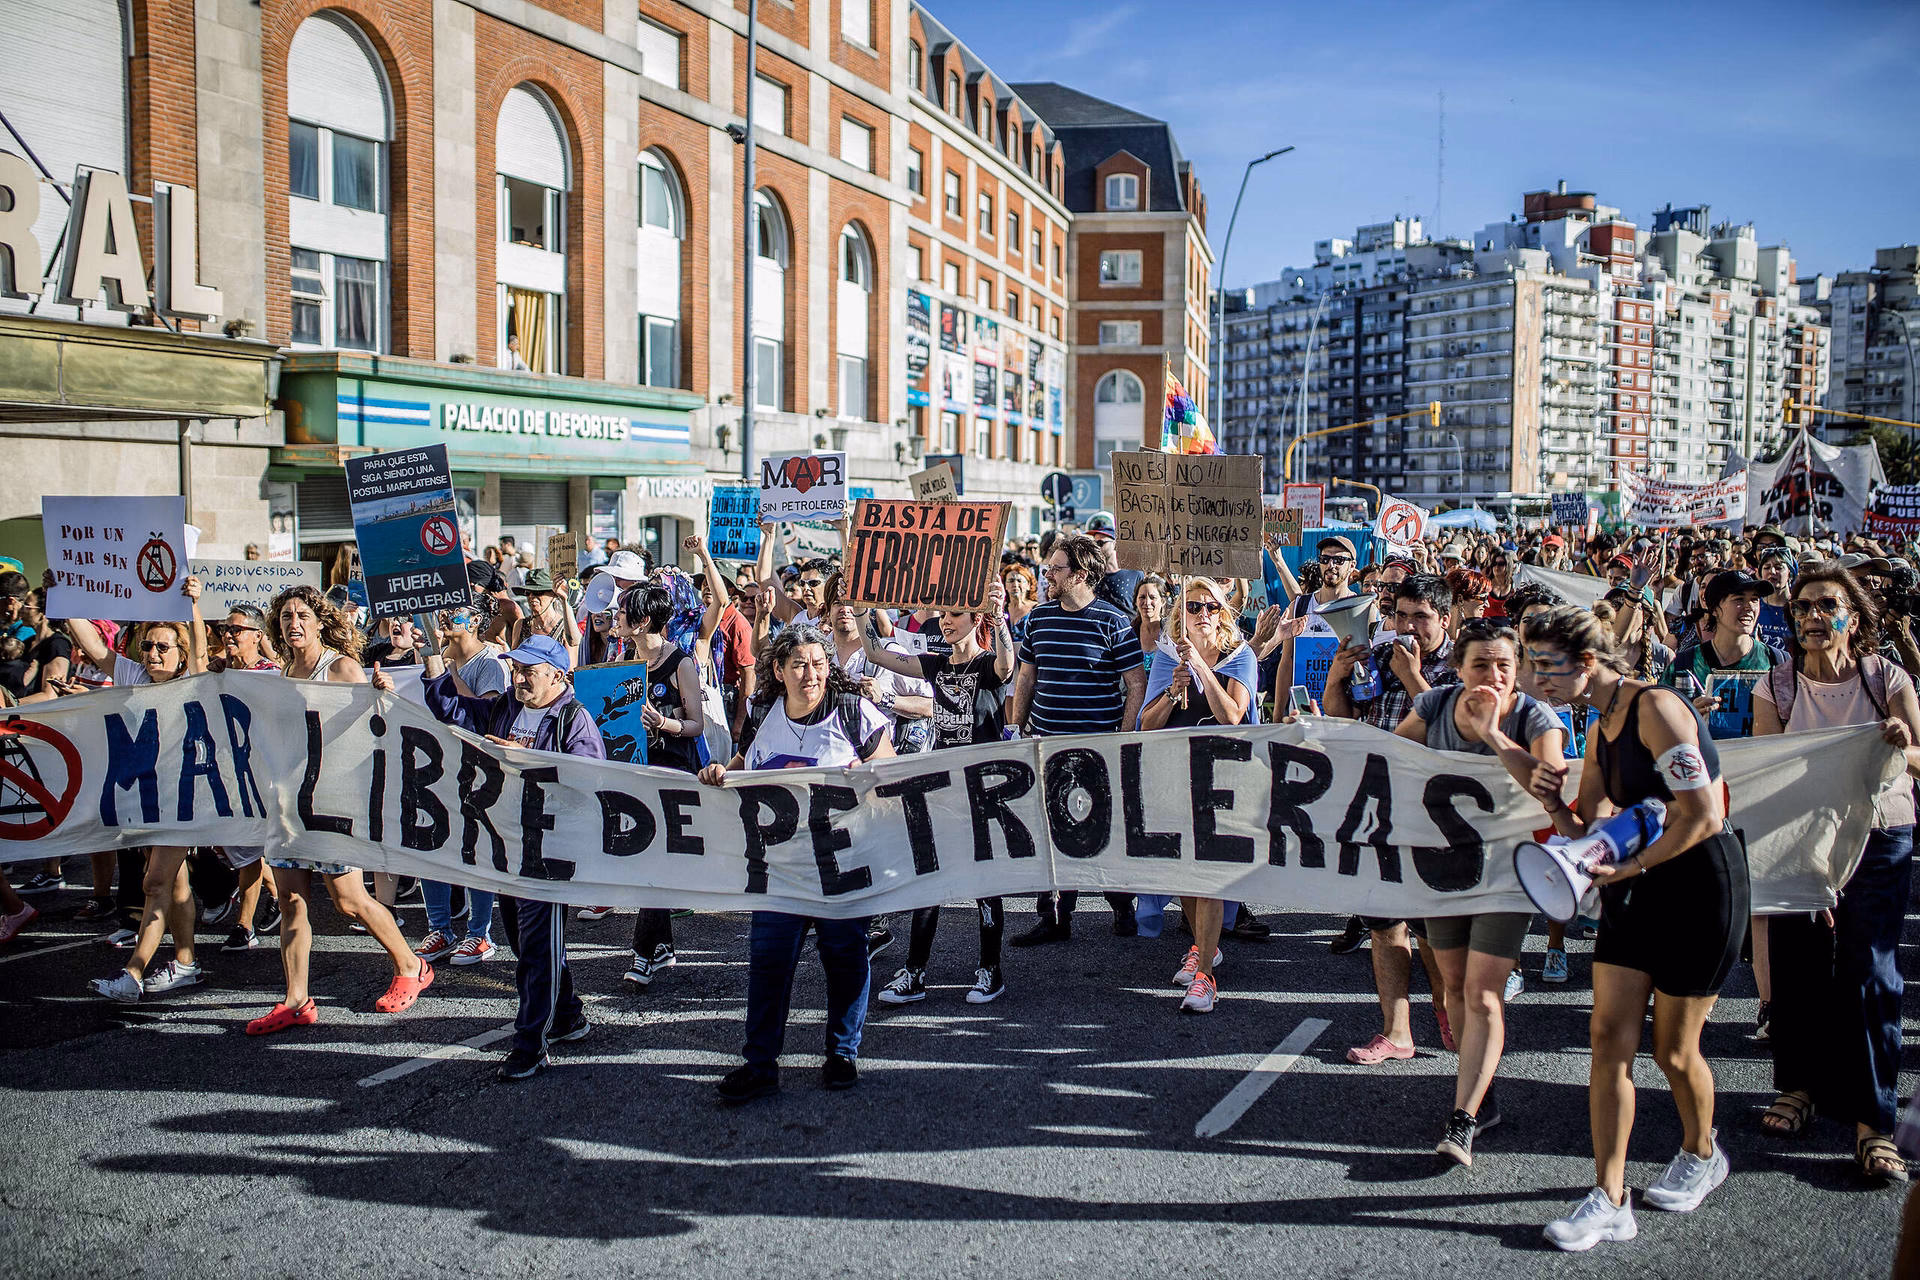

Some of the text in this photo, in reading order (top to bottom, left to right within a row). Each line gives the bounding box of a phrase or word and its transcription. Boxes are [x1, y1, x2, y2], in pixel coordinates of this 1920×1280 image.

[442, 403, 628, 440] PALACIO DE DEPORTES
[364, 452, 429, 470] PARA QUE ESTA
[761, 456, 844, 490] MAR
[1119, 458, 1142, 481] NO
[1147, 461, 1164, 481] ES
[361, 463, 435, 484] SIGA SIENDO UNA
[353, 474, 448, 498] POSTAL MARPLATENSE
[761, 499, 845, 513] SIN PETROLERAS
[1119, 488, 1167, 517] BASTA
[1171, 496, 1185, 513] DE
[863, 503, 946, 531] BASTA
[956, 507, 993, 533] DE
[61, 525, 124, 543] POR UN
[1120, 519, 1250, 543] SÍ A LAS ENERGÍAS
[62, 549, 128, 570] MAR SIN
[192, 565, 210, 577] LA
[850, 529, 993, 608] TERRICIDIO
[56, 569, 133, 600] PETROLEO
[256, 583, 273, 592] NO
[388, 571, 445, 594] ¡FUERA
[374, 587, 467, 616] PETROLERAS!
[1718, 688, 1739, 713] EL
[100, 694, 267, 827] MAR
[595, 788, 705, 857] DE
[736, 735, 1495, 896] PETROLERAS
